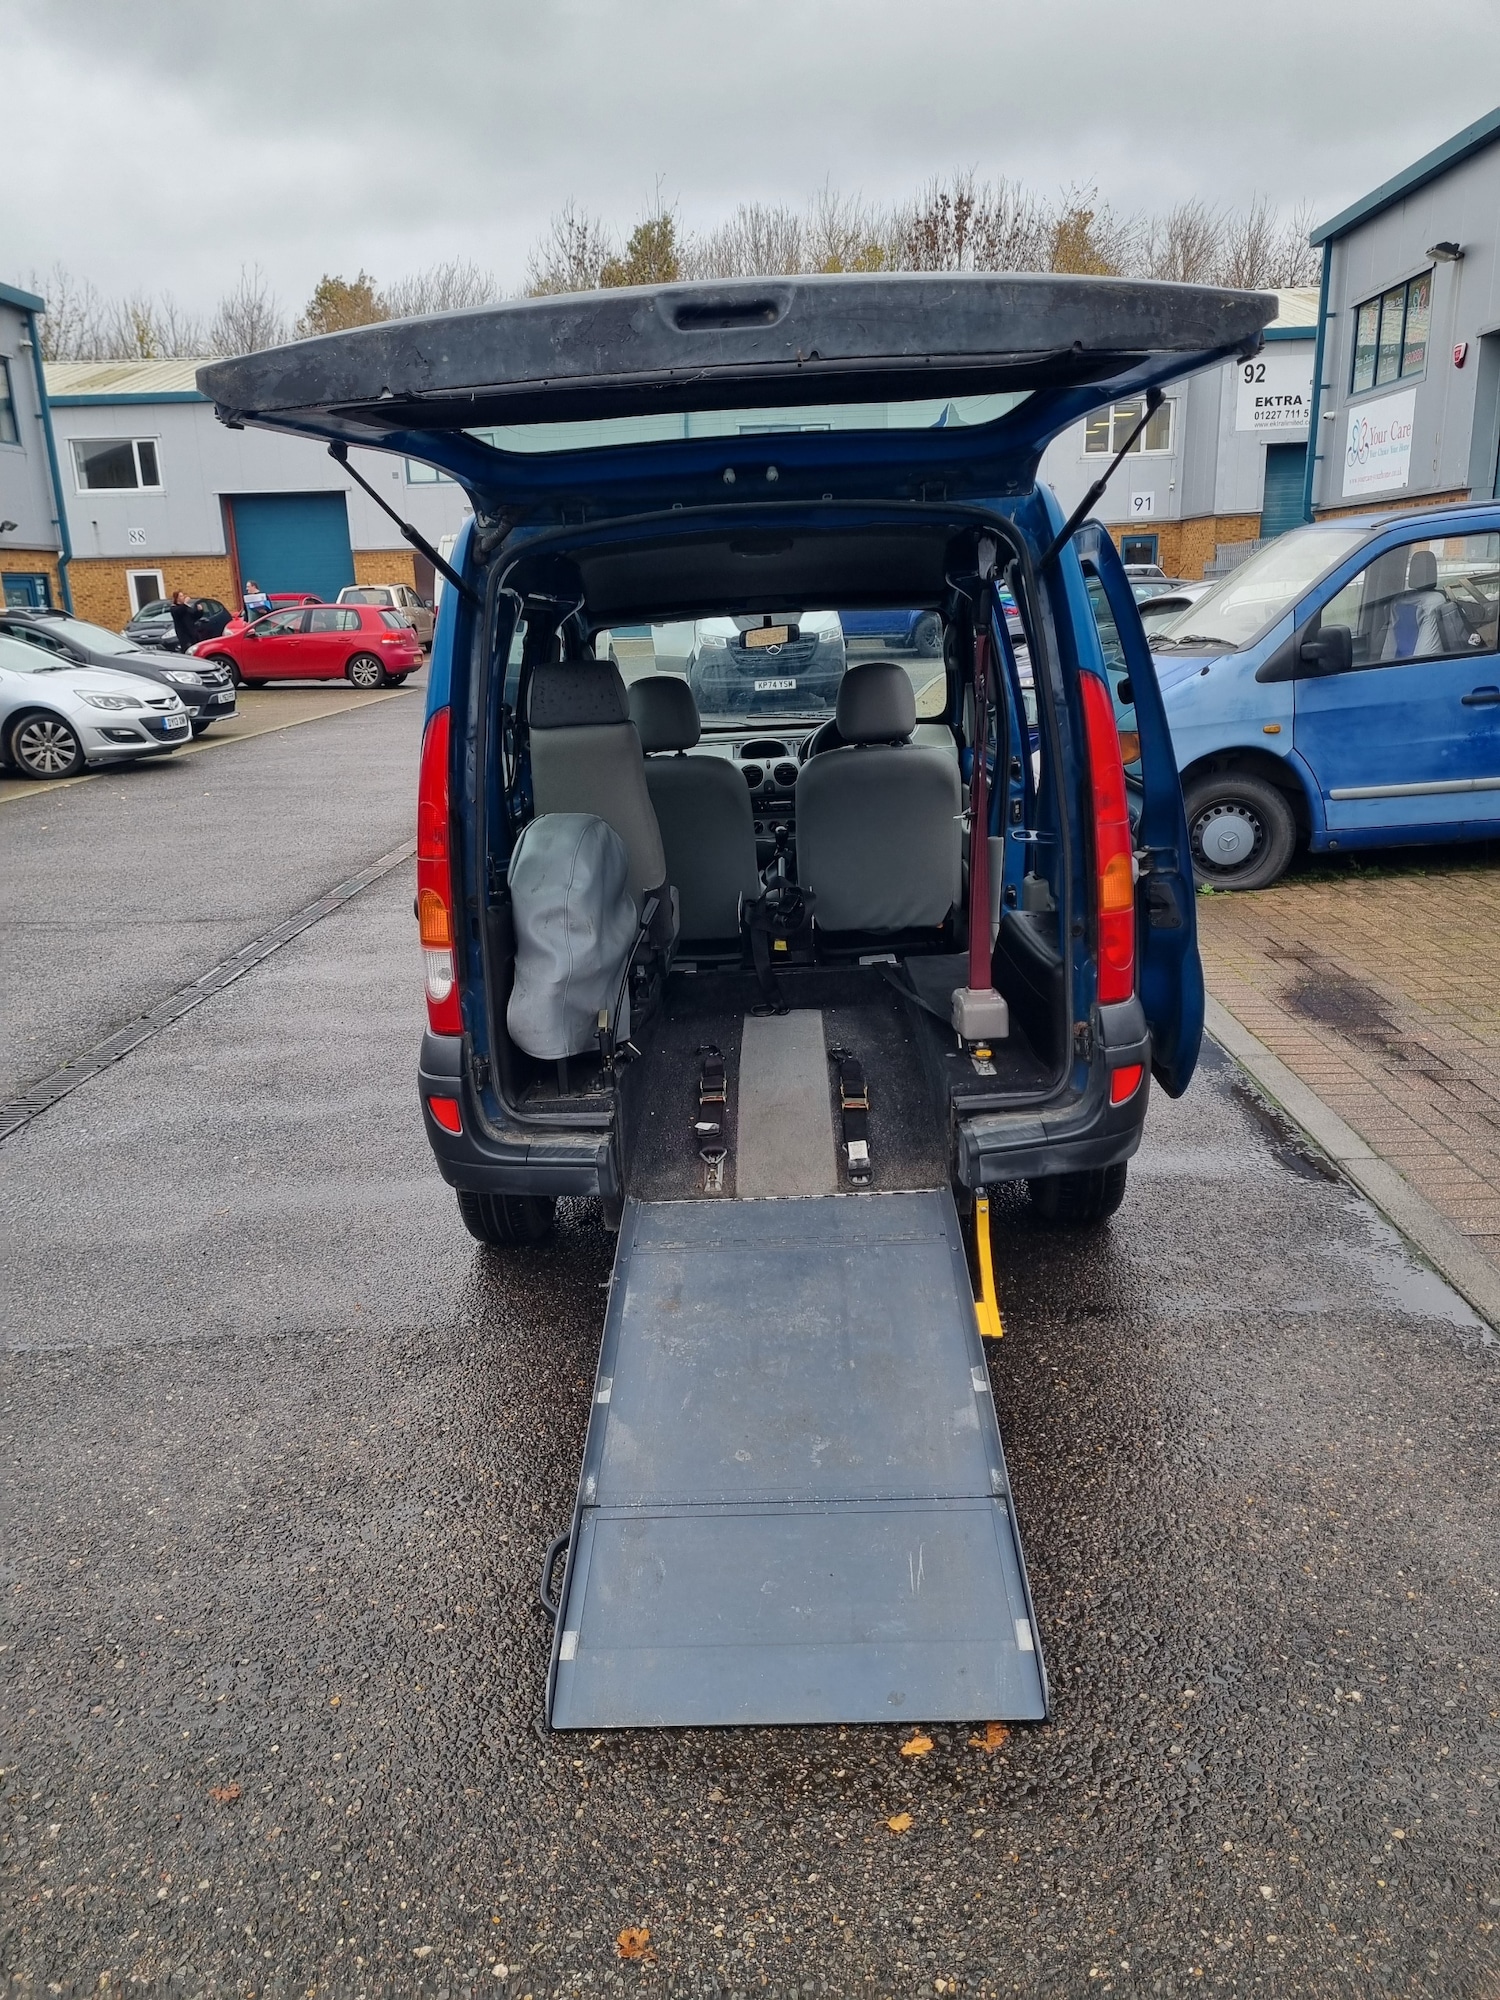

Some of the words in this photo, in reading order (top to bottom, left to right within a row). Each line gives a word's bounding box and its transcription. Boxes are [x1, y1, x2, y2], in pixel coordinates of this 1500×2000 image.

[1244, 363, 1266, 384] 92
[1255, 395, 1303, 407] EKTRA
[1254, 410, 1282, 421] 01227
[1284, 409, 1300, 419] 711
[1303, 408, 1309, 418] 5
[1369, 426, 1388, 446] Your
[1390, 420, 1412, 441] Care
[1134, 496, 1151, 511] 91
[129, 530, 146, 543] 88
[758, 680, 777, 689] KP74
